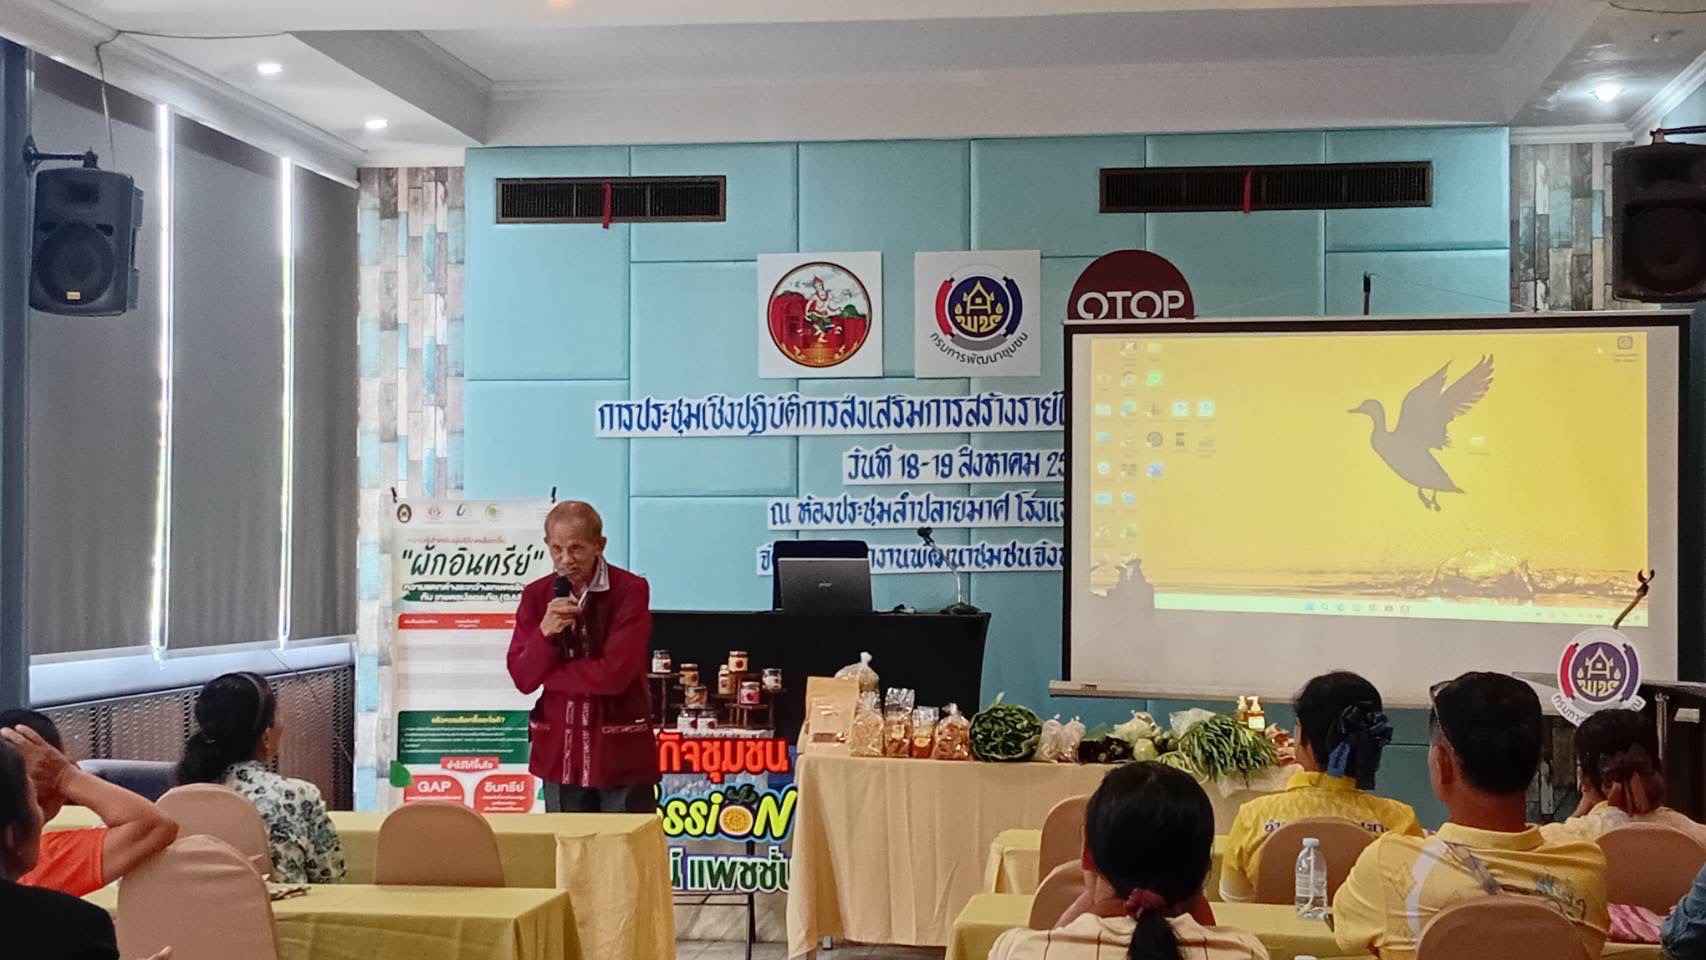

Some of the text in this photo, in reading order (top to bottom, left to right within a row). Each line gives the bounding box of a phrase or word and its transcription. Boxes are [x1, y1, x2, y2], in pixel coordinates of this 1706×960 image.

[1077, 290, 1185, 319] OTOP
[930, 331, 1029, 366] กรมการพัฒนาชุมชน
[599, 391, 1065, 435] การประชุมเชิงปฏิบัติการส่งเสริมการสร้างรายไ
[848, 445, 894, 480] วันที่
[899, 452, 953, 479] 18-19
[958, 446, 1040, 479] สิงหาคม
[771, 502, 791, 525] ณ
[659, 733, 788, 783] กิจชุมชน
[417, 780, 452, 793] GAP
[484, 780, 525, 793] อินทรีย์
